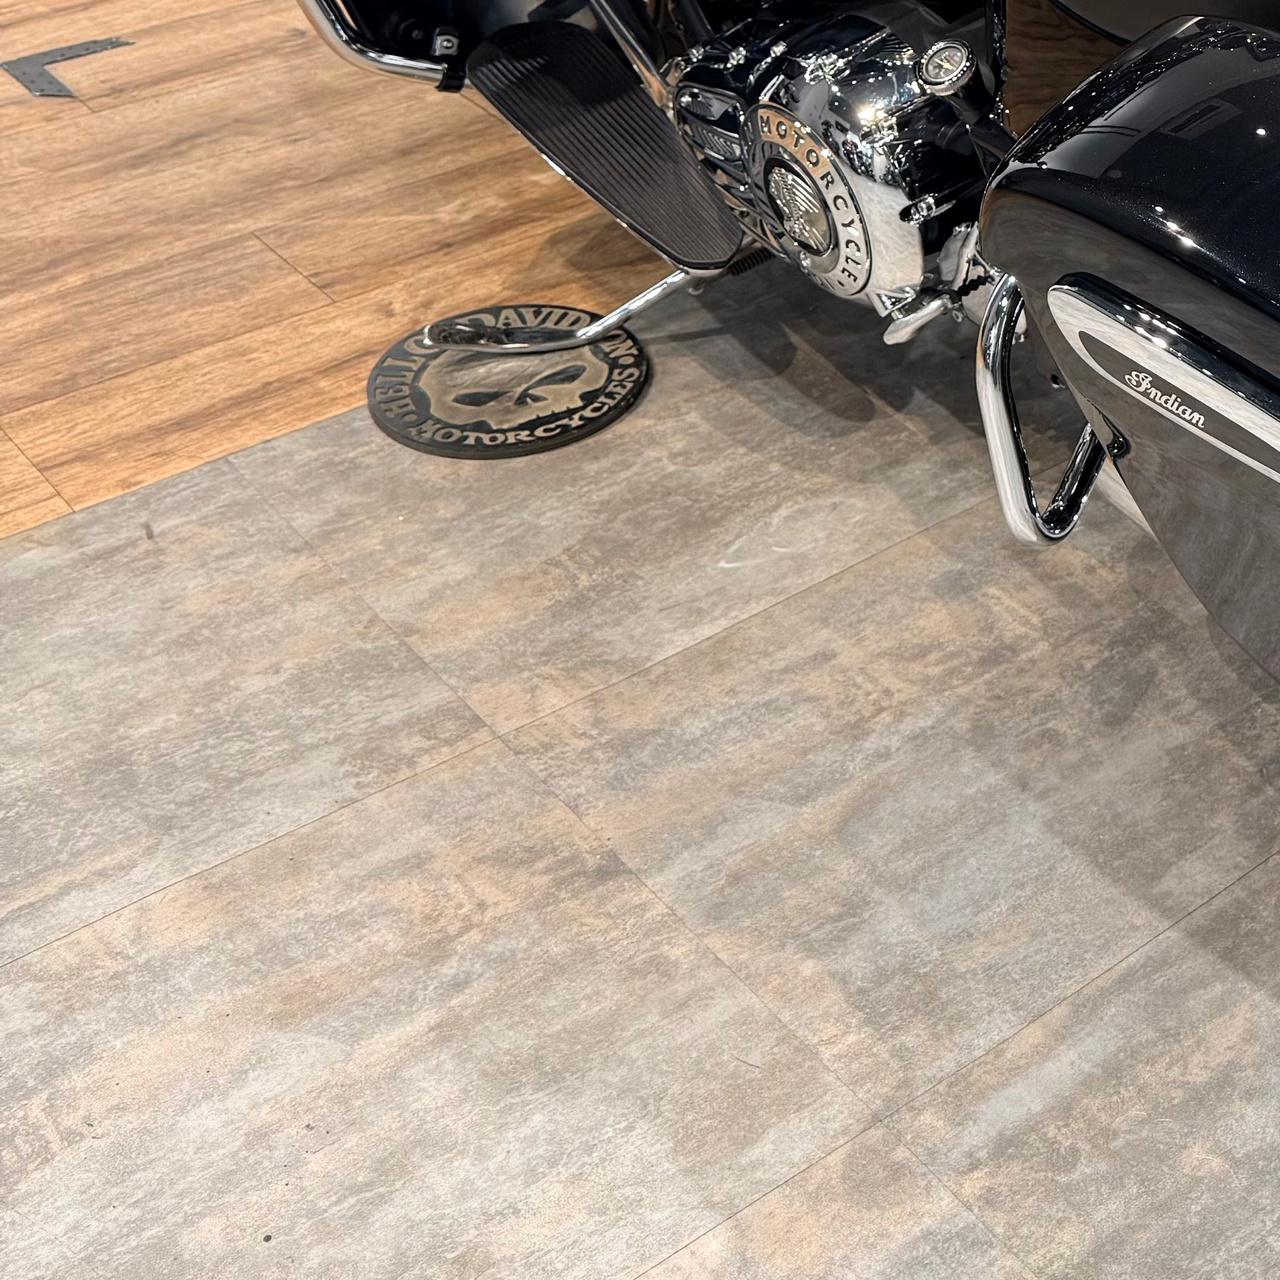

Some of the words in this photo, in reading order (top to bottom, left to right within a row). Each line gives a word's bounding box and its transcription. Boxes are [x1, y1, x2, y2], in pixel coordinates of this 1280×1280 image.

[759, 114, 862, 283] MOTORCYCLE
[409, 367, 641, 446] MOTORCYCLES
[1124, 370, 1205, 428] Indian
